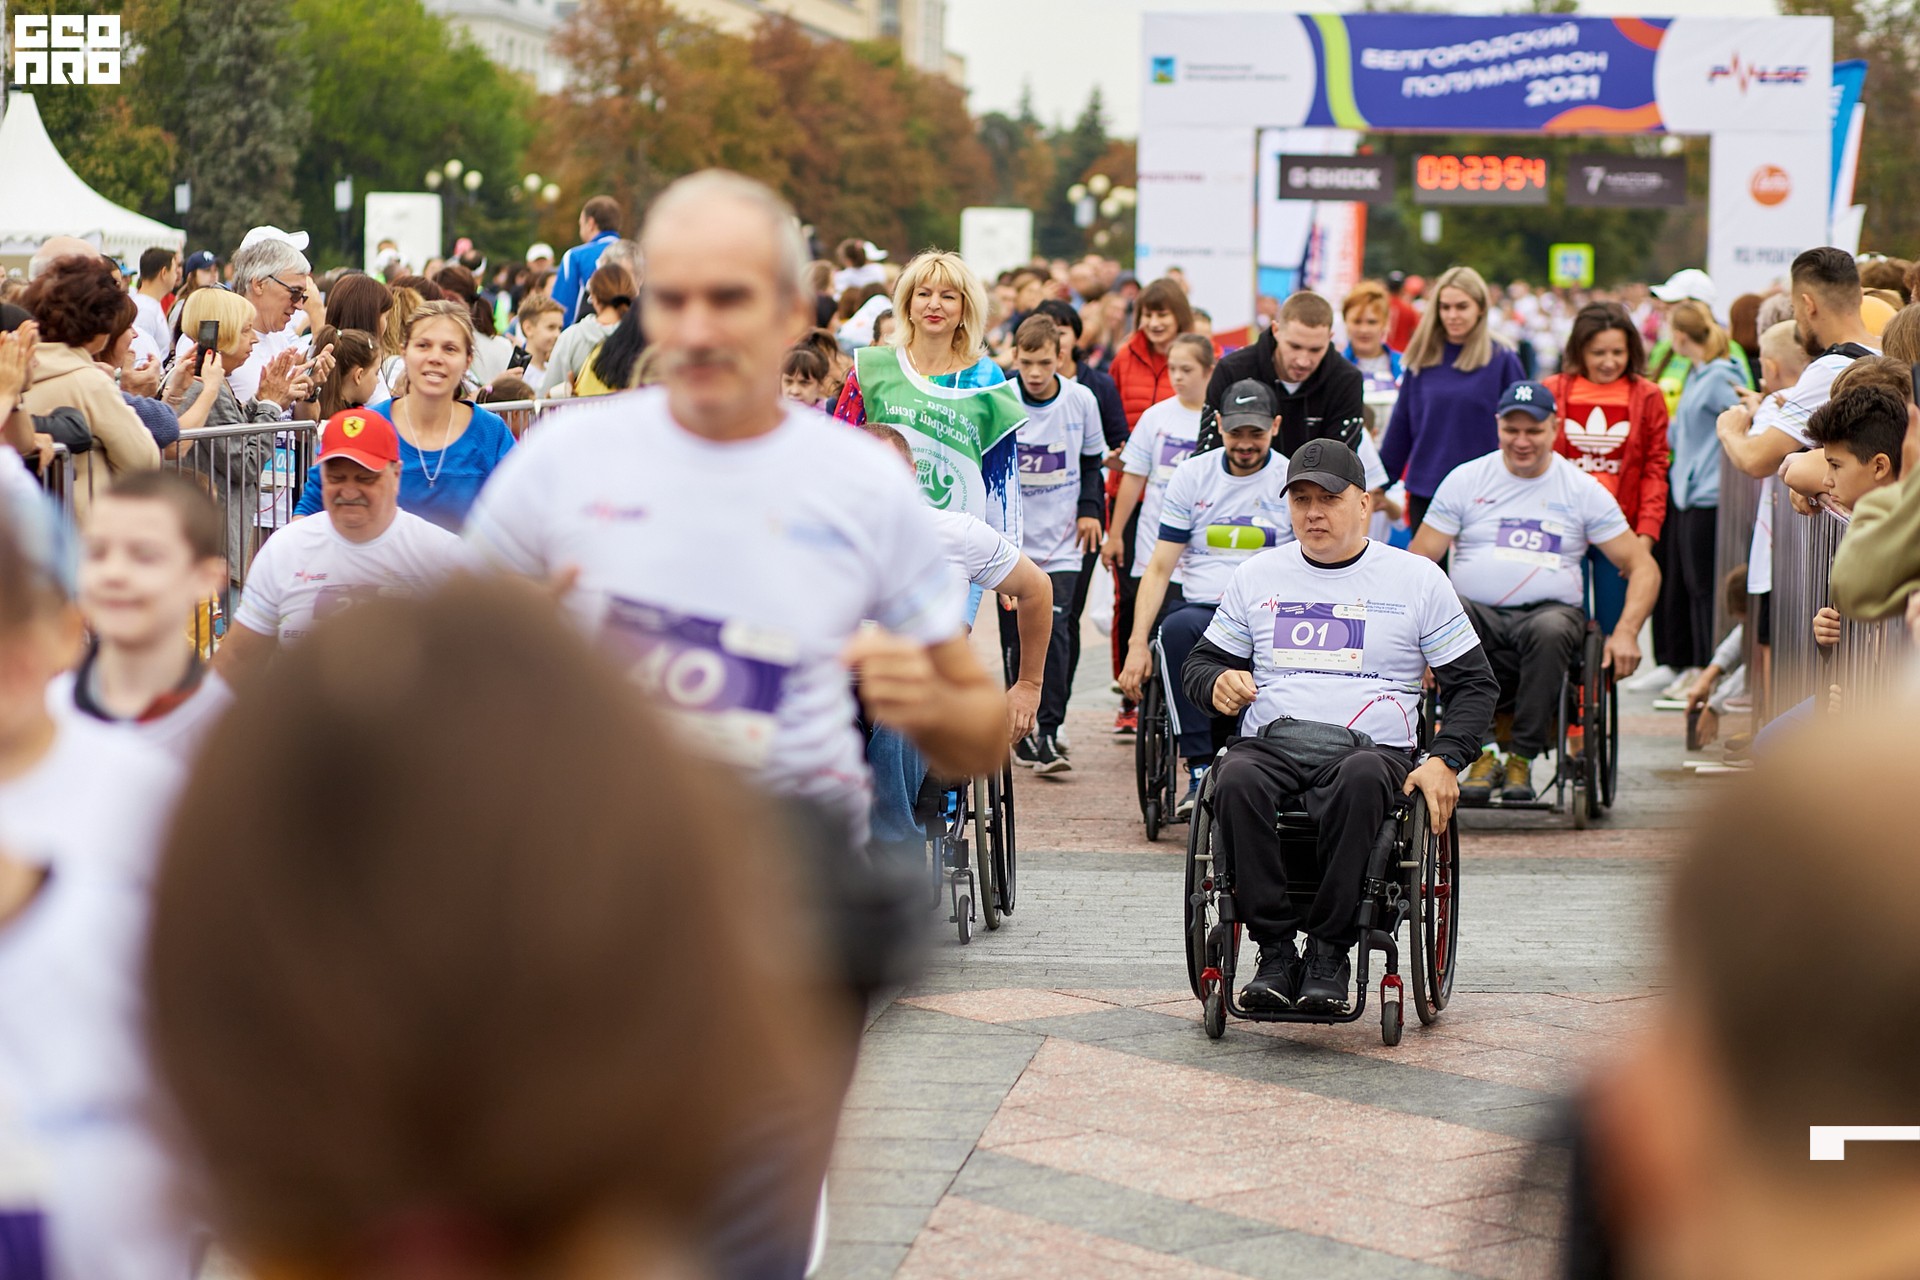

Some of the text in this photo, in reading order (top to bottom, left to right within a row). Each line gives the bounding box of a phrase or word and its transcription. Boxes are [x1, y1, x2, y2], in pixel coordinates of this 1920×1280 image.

[1361, 21, 1579, 71] БЕЛГОРОДСКИЙ
[1401, 50, 1608, 99] ПОЛУМАРАФОН
[1524, 74, 1600, 107] 2021
[1019, 455, 1043, 472] 21
[1302, 443, 1324, 468] 9
[1567, 454, 1622, 474] dida
[1228, 527, 1240, 548] 1
[1508, 529, 1543, 550] 05
[1291, 621, 1329, 647] 01
[628, 645, 724, 705] 40
